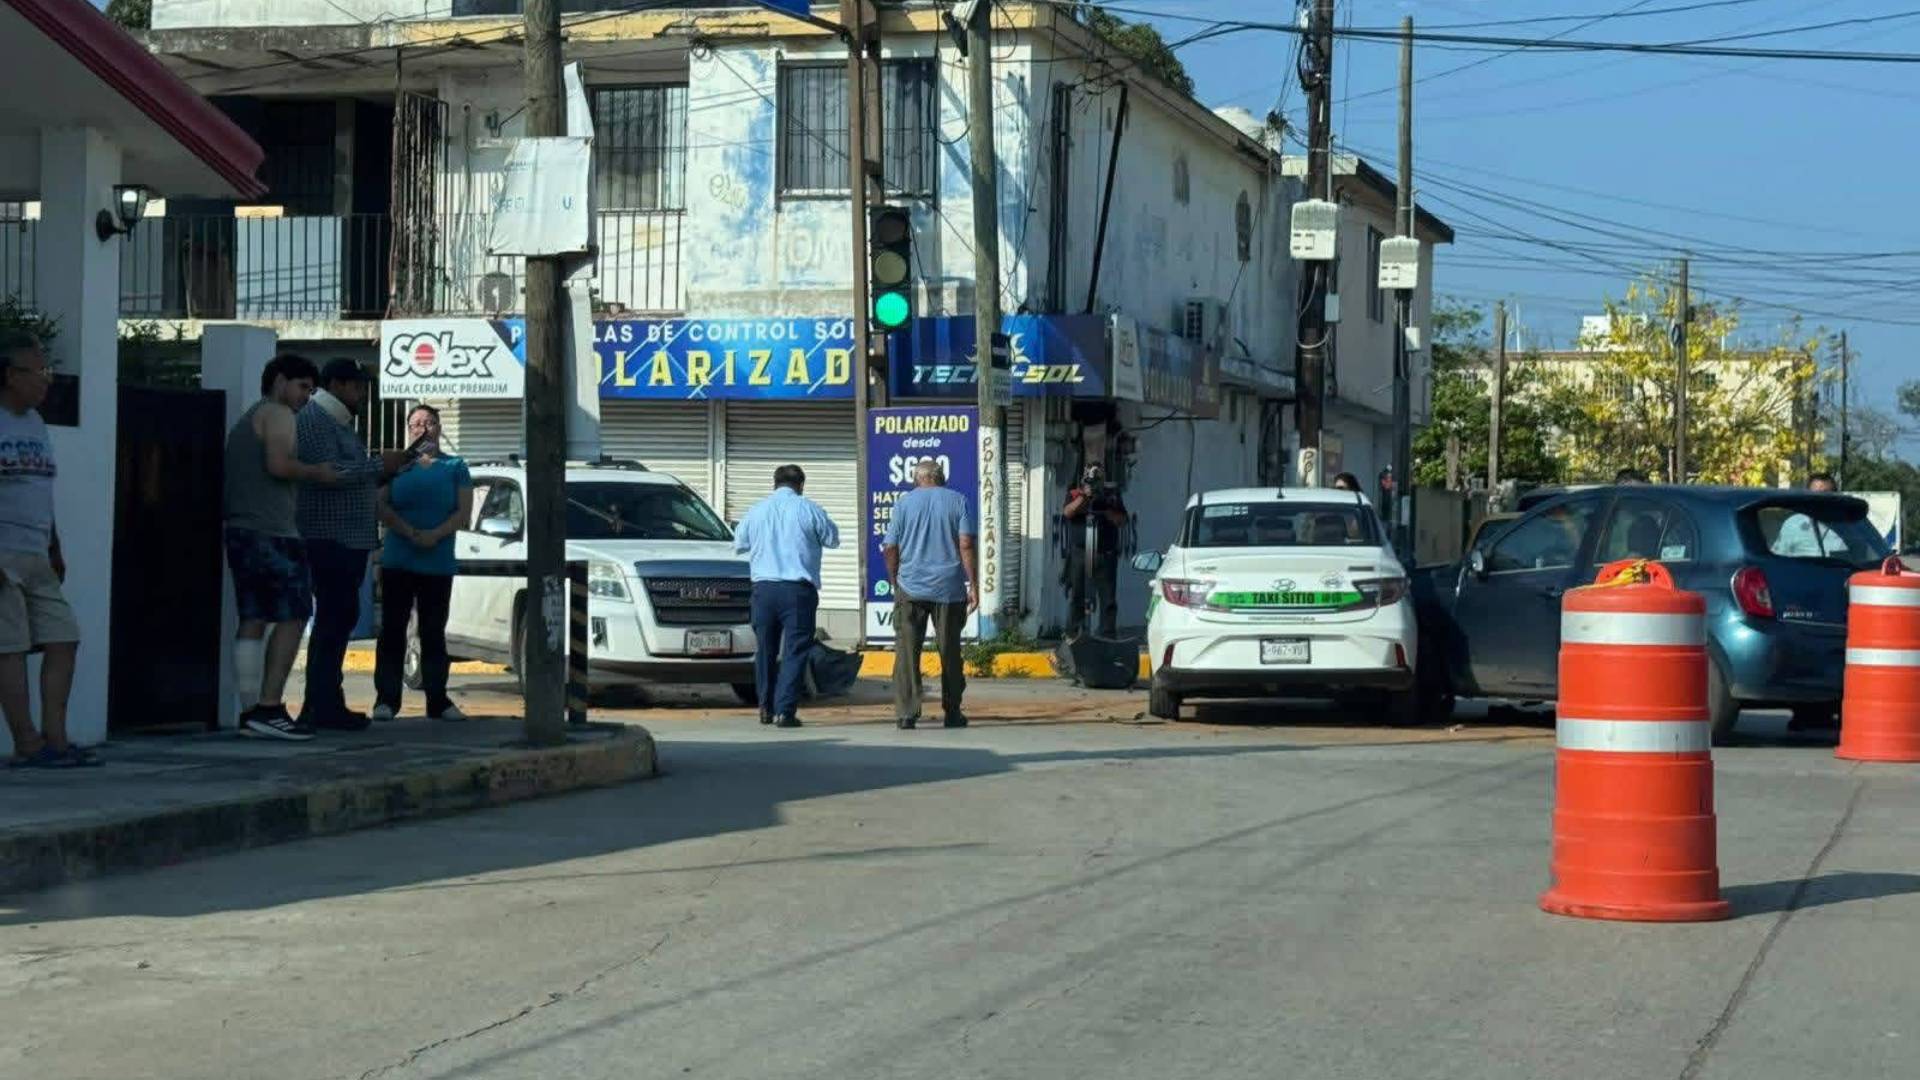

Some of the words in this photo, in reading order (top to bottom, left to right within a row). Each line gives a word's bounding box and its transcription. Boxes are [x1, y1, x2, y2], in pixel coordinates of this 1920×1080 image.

[648, 323, 674, 341] DE
[688, 321, 799, 341] CONTROL
[413, 383, 457, 394] CERAMIC
[460, 383, 508, 394] PREMIUM
[875, 415, 969, 434] POLARIZADO
[902, 436, 941, 449] desde
[982, 436, 996, 593] POLARIZADOS
[1252, 592, 1280, 604] TAXI
[1282, 592, 1315, 604] SITIO
